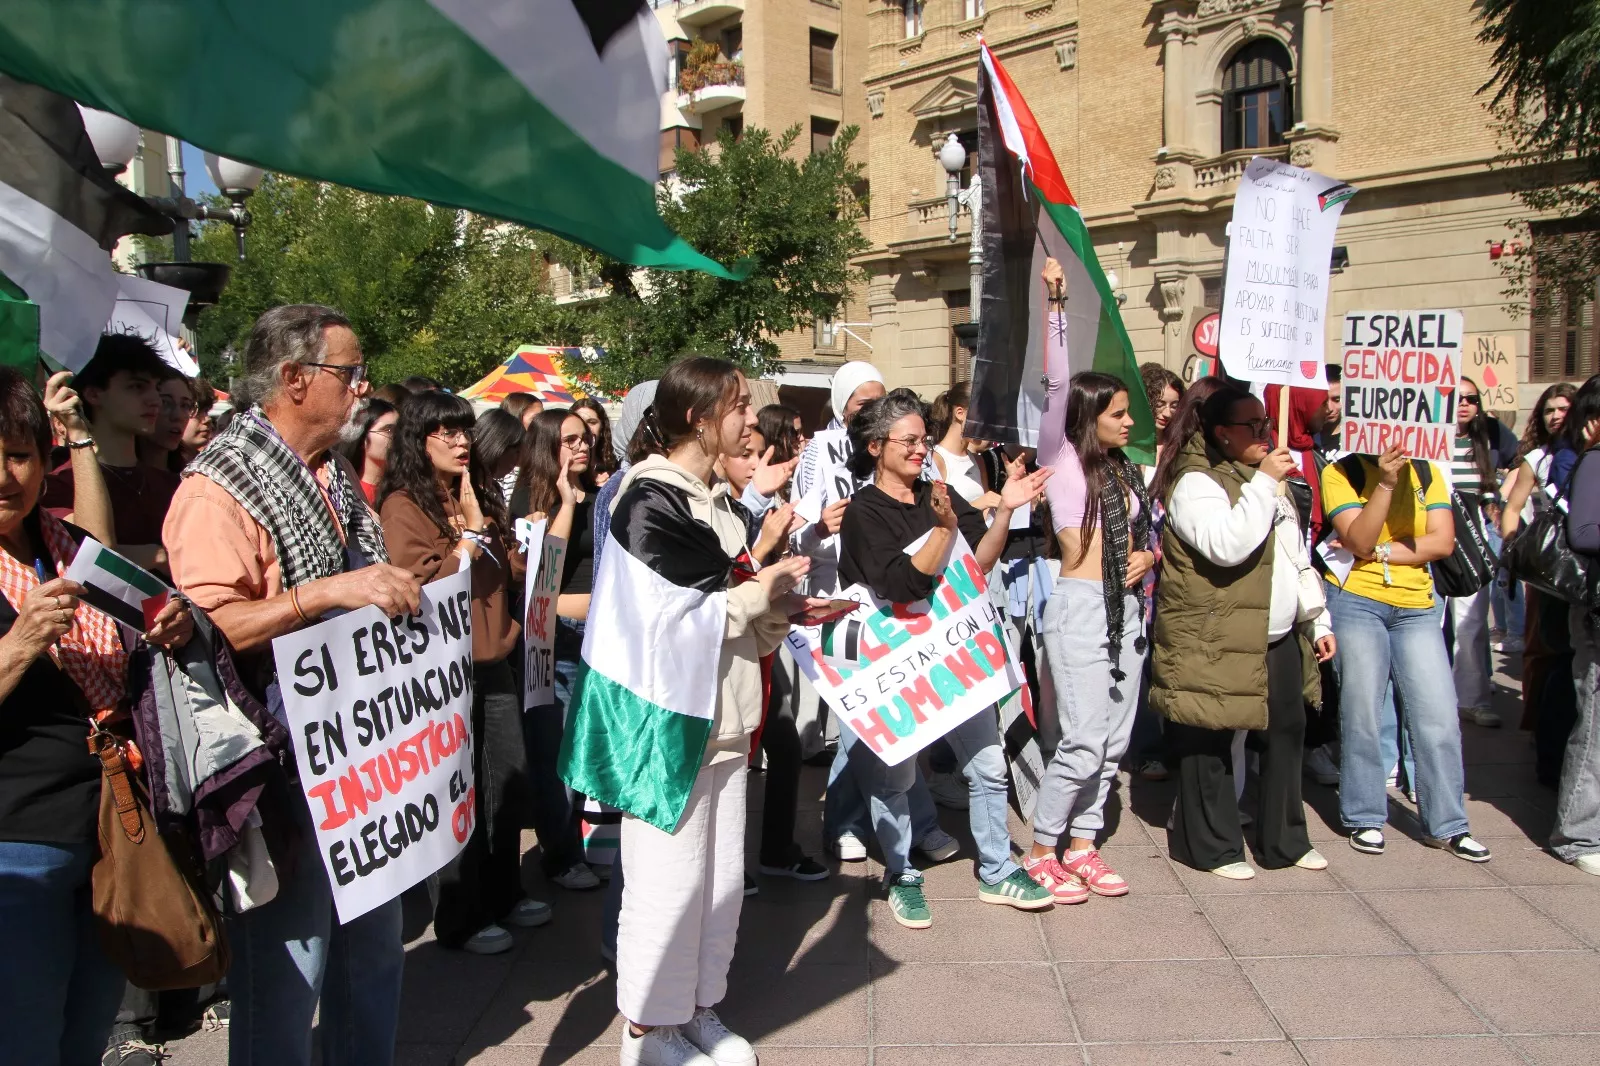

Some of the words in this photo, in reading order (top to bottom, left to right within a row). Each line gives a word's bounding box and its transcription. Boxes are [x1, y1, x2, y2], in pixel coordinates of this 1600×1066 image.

[1255, 196, 1276, 222] NO
[1292, 204, 1312, 231] HACE
[1239, 226, 1275, 250] FALTA
[1284, 234, 1300, 255] SER
[1303, 272, 1319, 290] PARA
[1234, 290, 1274, 315] APOYAR
[1283, 299, 1290, 315] A
[1240, 318, 1251, 336] ES
[1304, 331, 1313, 347] SER
[1345, 314, 1457, 348] ISRAEL
[1245, 342, 1294, 369] humano
[1344, 349, 1456, 385] GENOCIDA
[1473, 351, 1509, 366] UNA
[1345, 386, 1432, 424] EUROPA
[1345, 421, 1451, 461] PATROCINA
[544, 544, 563, 592] DE
[293, 642, 338, 697] SI
[352, 610, 431, 676] ERES
[438, 590, 472, 644] NE
[840, 687, 868, 712] ES
[876, 642, 941, 694] ESTAR
[945, 614, 981, 647] CON
[982, 601, 997, 622] LA
[304, 712, 347, 775] EN
[352, 651, 473, 747] SITUACION
[329, 793, 439, 887] ELEGIDO
[449, 769, 467, 803] EL
